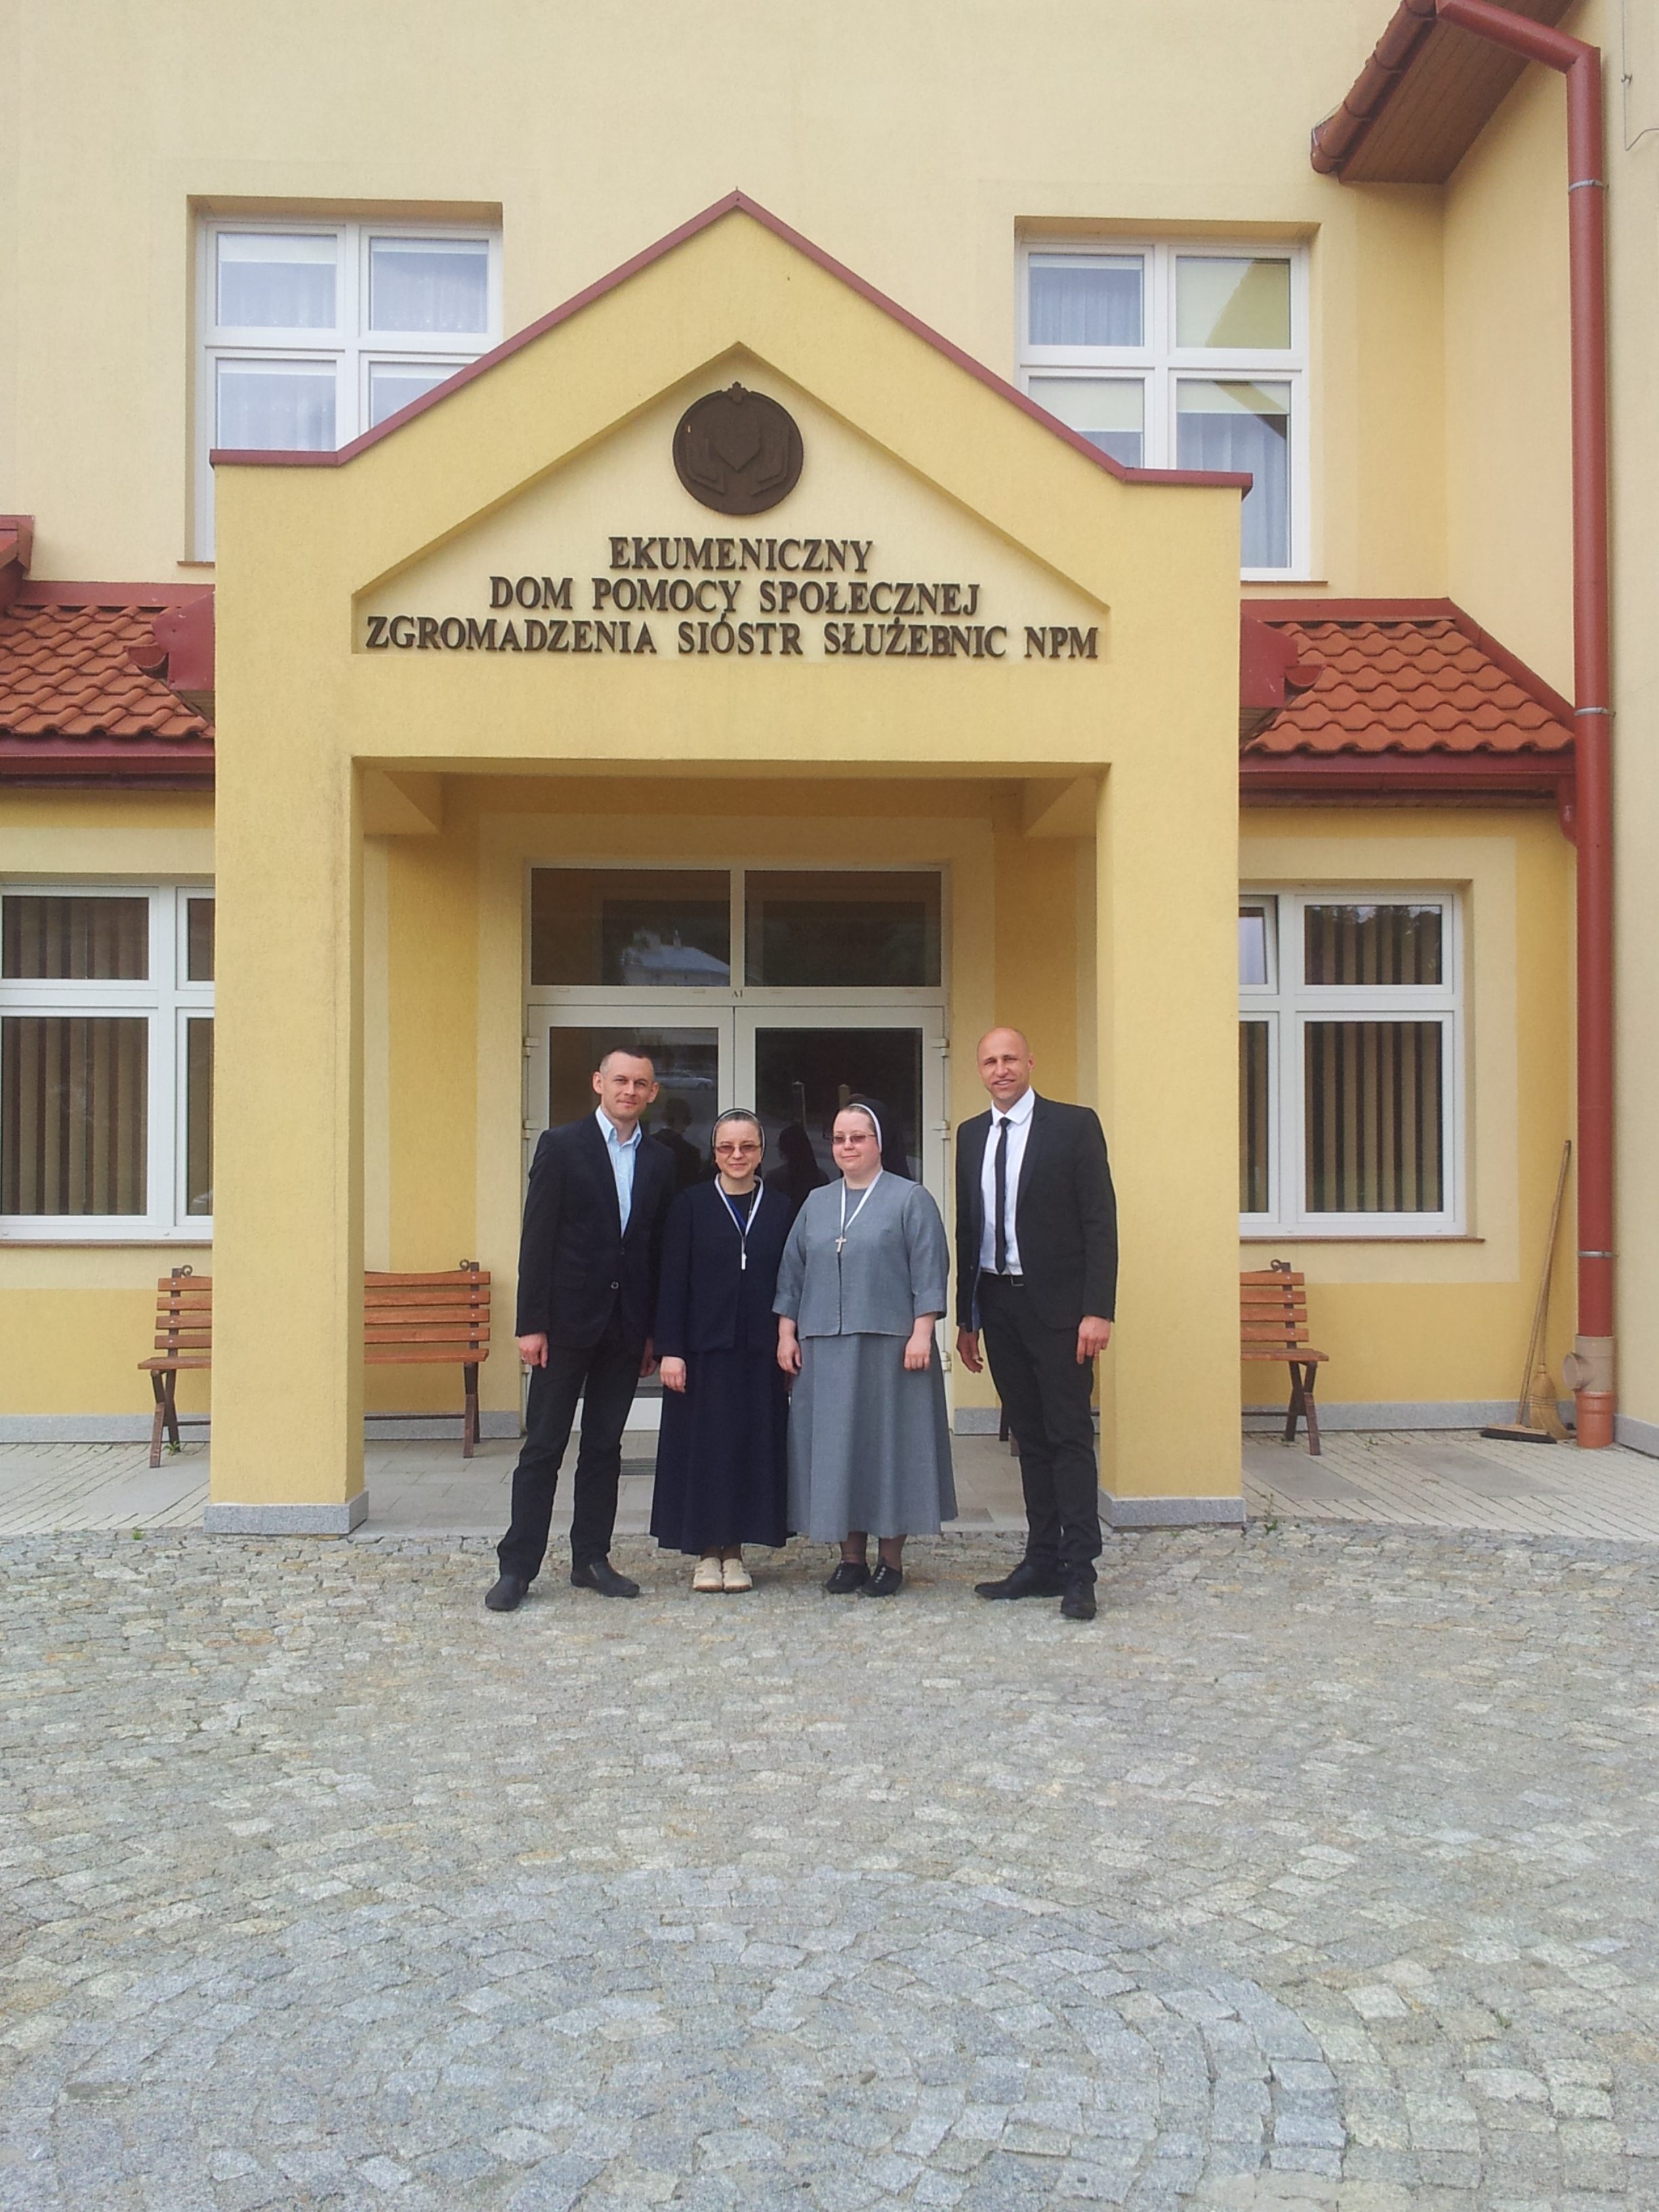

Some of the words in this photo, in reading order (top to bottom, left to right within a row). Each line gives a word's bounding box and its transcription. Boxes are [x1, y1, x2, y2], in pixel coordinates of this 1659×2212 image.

[609, 537, 873, 573] EKUMENICZNY
[489, 576, 573, 611] DOM
[592, 578, 741, 613] POMOCY
[760, 580, 980, 617] SPOŁECZNEJ
[365, 615, 657, 654] ZGROMADZENIA
[678, 612, 804, 655] SIÓSTR
[823, 616, 1007, 659] SŁUŻEBNIC
[1024, 626, 1099, 659] NPM
